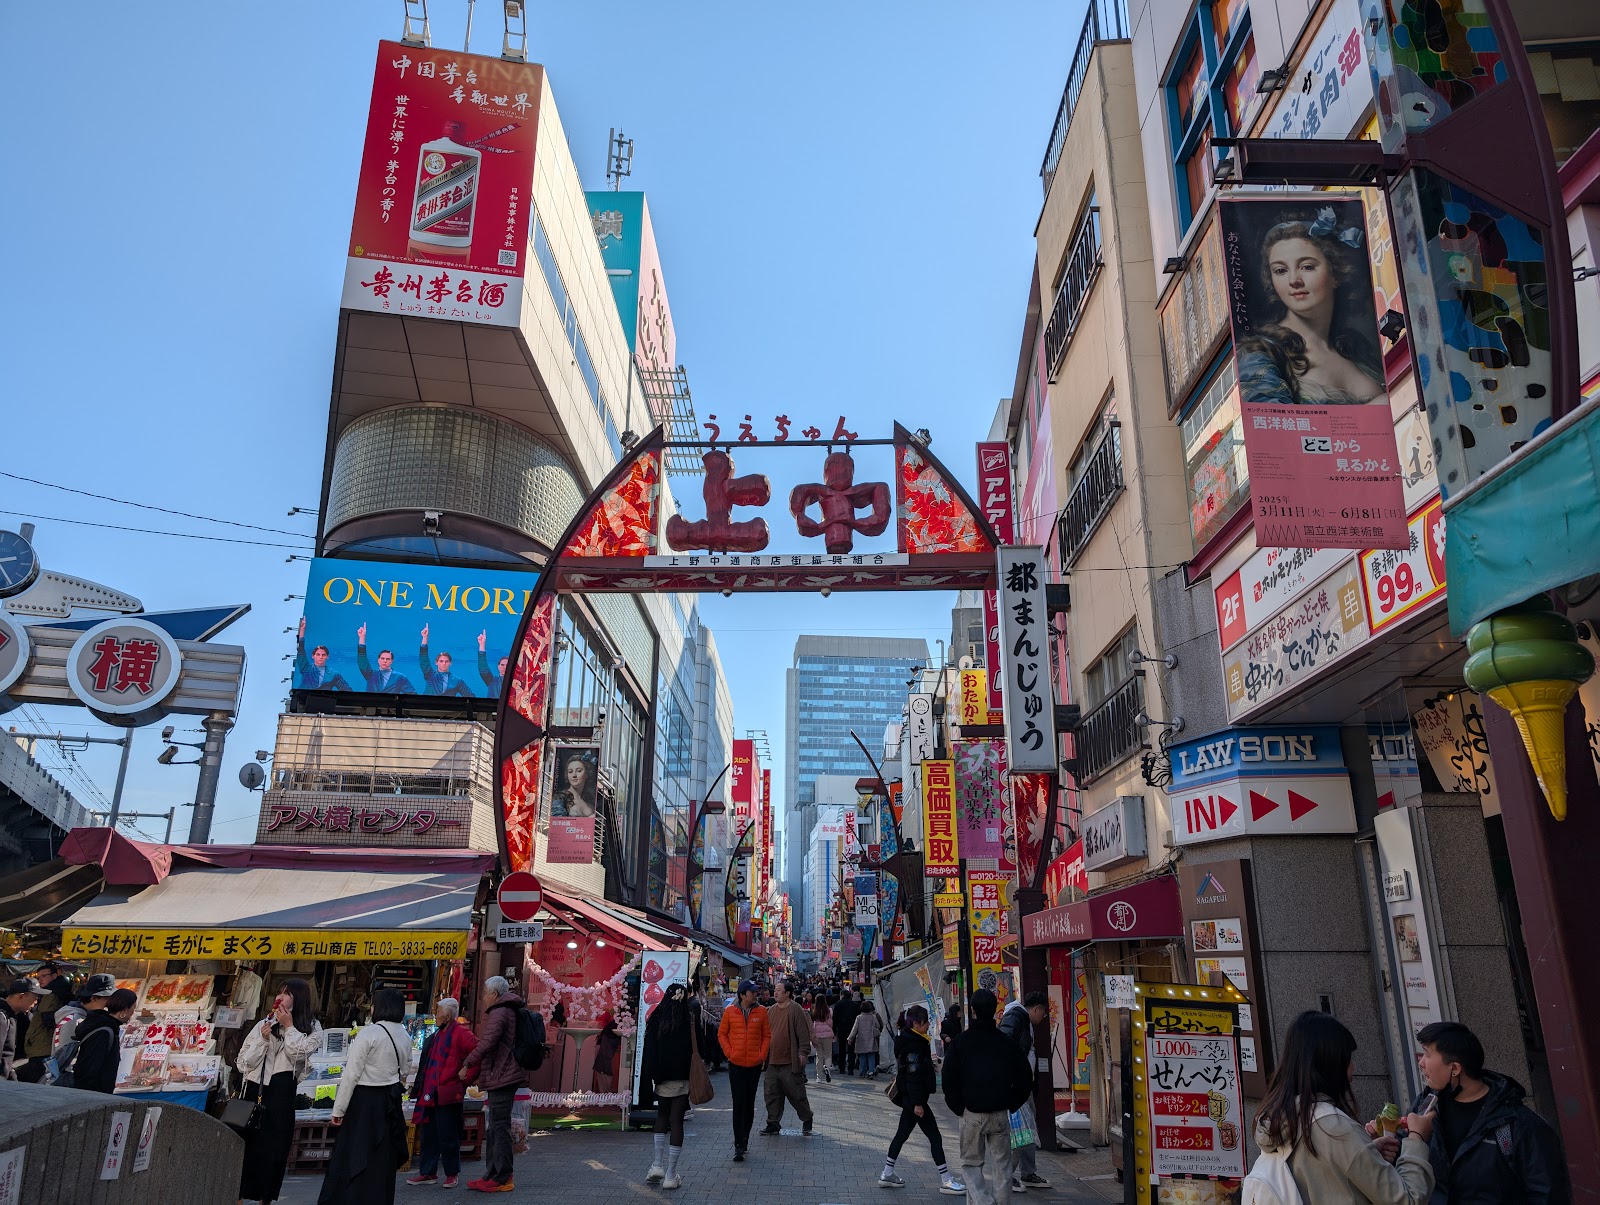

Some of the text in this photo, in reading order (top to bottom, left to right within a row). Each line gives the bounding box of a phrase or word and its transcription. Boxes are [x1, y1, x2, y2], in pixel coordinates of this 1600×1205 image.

[392, 55, 478, 84] 中国茅台
[380, 95, 410, 224] 世界に漂う 茅台の香り
[504, 187, 519, 247] 日和商事株式会社
[1227, 231, 1250, 331] あなたに会いたい。
[703, 414, 859, 442] うえちゅん
[1252, 415, 1317, 431] 西洋絵画、
[984, 477, 1009, 545] アドアー
[1258, 495, 1291, 504] 2025年
[1304, 525, 1384, 537] 国立西洋美術館
[668, 556, 885, 567] 上野中通商店街振興組合
[323, 577, 414, 608] ONE
[1377, 562, 1423, 613] 99円
[1222, 592, 1240, 628] 2F
[1344, 589, 1359, 622] 串
[88, 636, 160, 695] 横
[1005, 562, 1044, 751] 都まんじゅう
[1245, 622, 1340, 703] 串かつ でんがな
[1230, 669, 1242, 696] 串
[1179, 735, 1317, 776] LAWSON
[267, 804, 461, 834] アメ横センター
[926, 762, 955, 863] 高価買取
[966, 783, 981, 830] 音楽祭
[1185, 795, 1217, 834] IN
[1085, 815, 1122, 858] 都まんじゅう
[926, 866, 958, 875] おたからや
[856, 896, 868, 905] MI
[972, 885, 985, 897] 金
[1196, 895, 1228, 904] NAGAFUJI
[71, 933, 155, 956] たらばがに
[163, 934, 215, 956] 毛がに
[223, 934, 273, 956] まぐろ
[499, 927, 541, 939] 自転車を除く
[975, 950, 1000, 963] バッグ
[1150, 1060, 1235, 1091] せんべろ セット
[1155, 1095, 1184, 1104] お好きな
[1167, 1099, 1208, 1113] ドリンク2杯
[1159, 1128, 1180, 1136] お任せ
[1162, 1133, 1211, 1148] 串かつ3本
